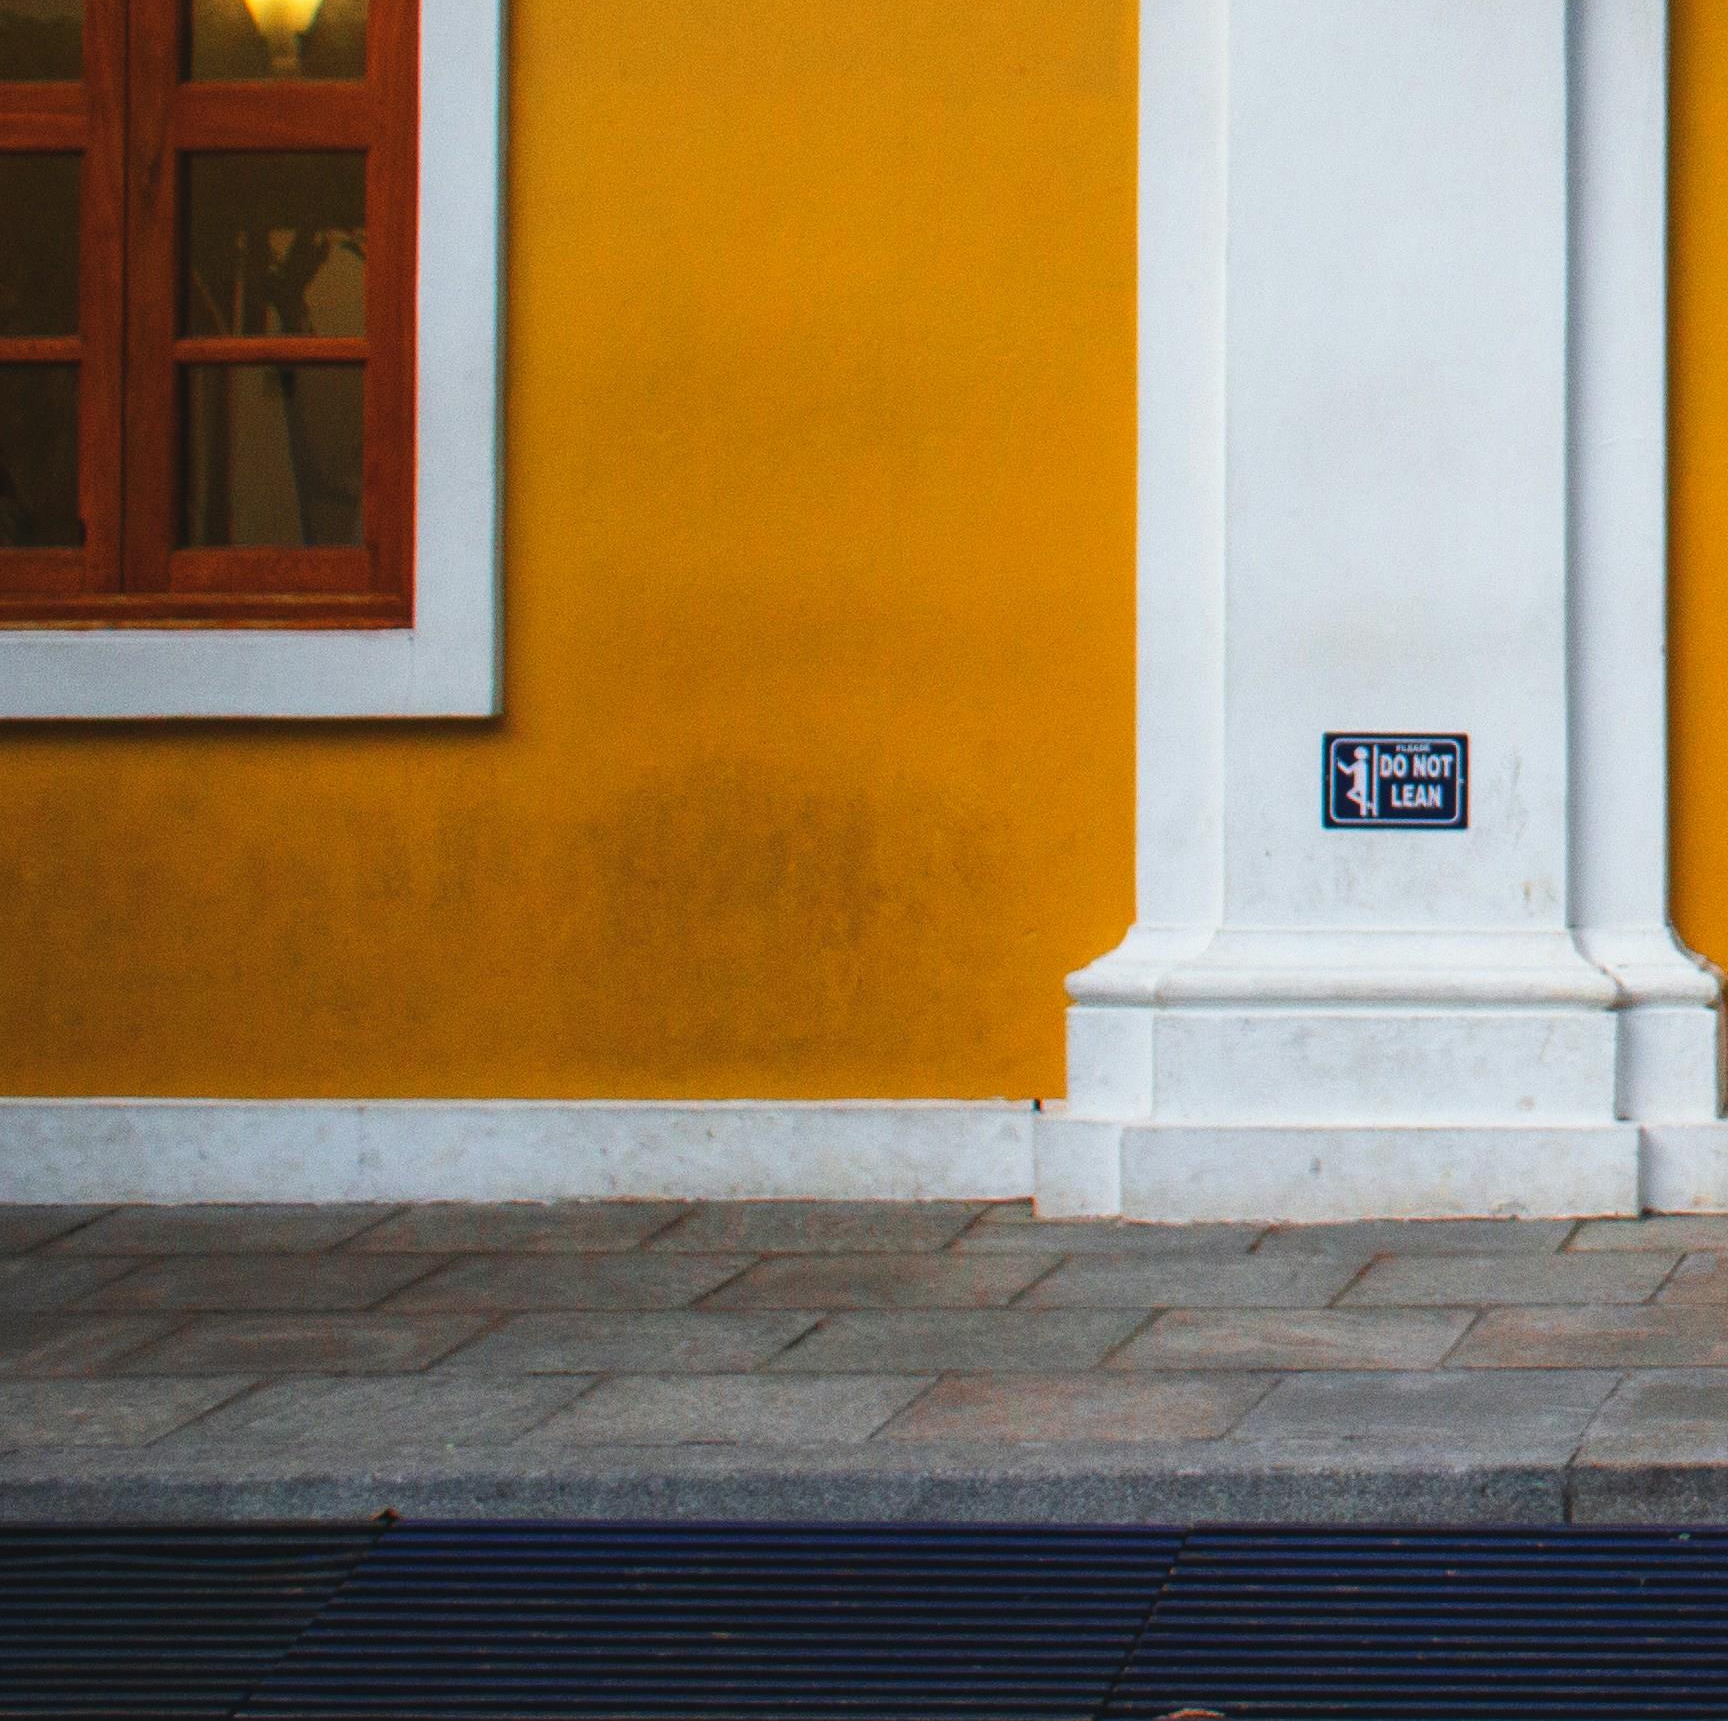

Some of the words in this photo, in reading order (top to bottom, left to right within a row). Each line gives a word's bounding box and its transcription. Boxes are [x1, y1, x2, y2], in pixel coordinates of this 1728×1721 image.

[1379, 754, 1408, 778] DO
[1412, 754, 1453, 778] NOT
[1391, 783, 1443, 808] LEAN
